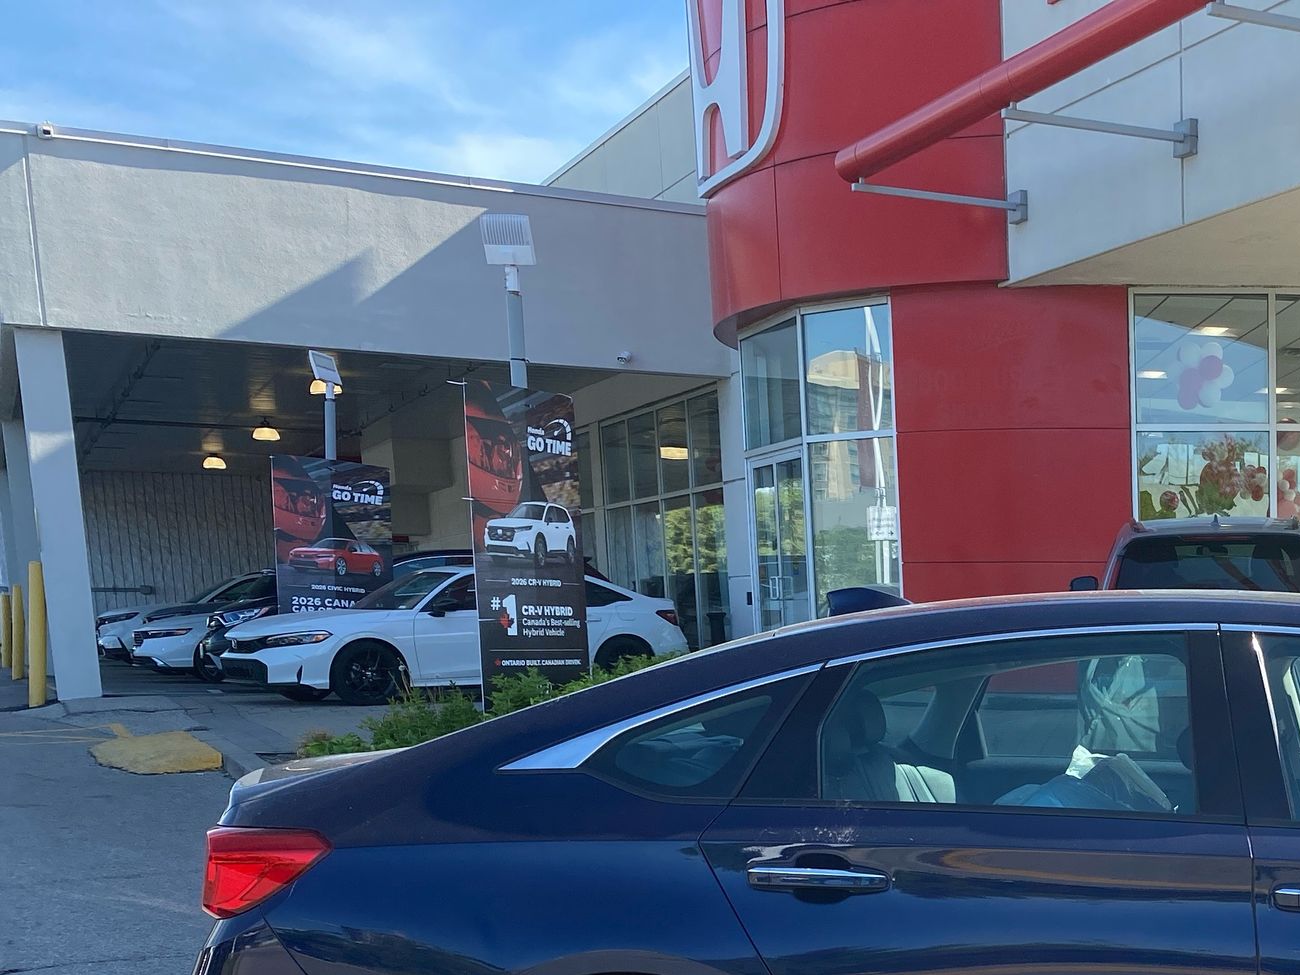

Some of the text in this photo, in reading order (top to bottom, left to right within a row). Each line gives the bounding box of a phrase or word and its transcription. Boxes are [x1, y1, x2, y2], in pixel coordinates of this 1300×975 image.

[527, 435, 572, 456] GO TIME
[332, 490, 383, 505] GO TIME
[511, 578, 527, 586] 2026
[542, 579, 562, 587] HYBRID
[291, 596, 321, 606] 2026
[522, 605, 573, 616] CR-V HYBRID
[522, 618, 581, 628] Canada's Best-selling
[522, 628, 565, 638] Hybrid Vehicle
